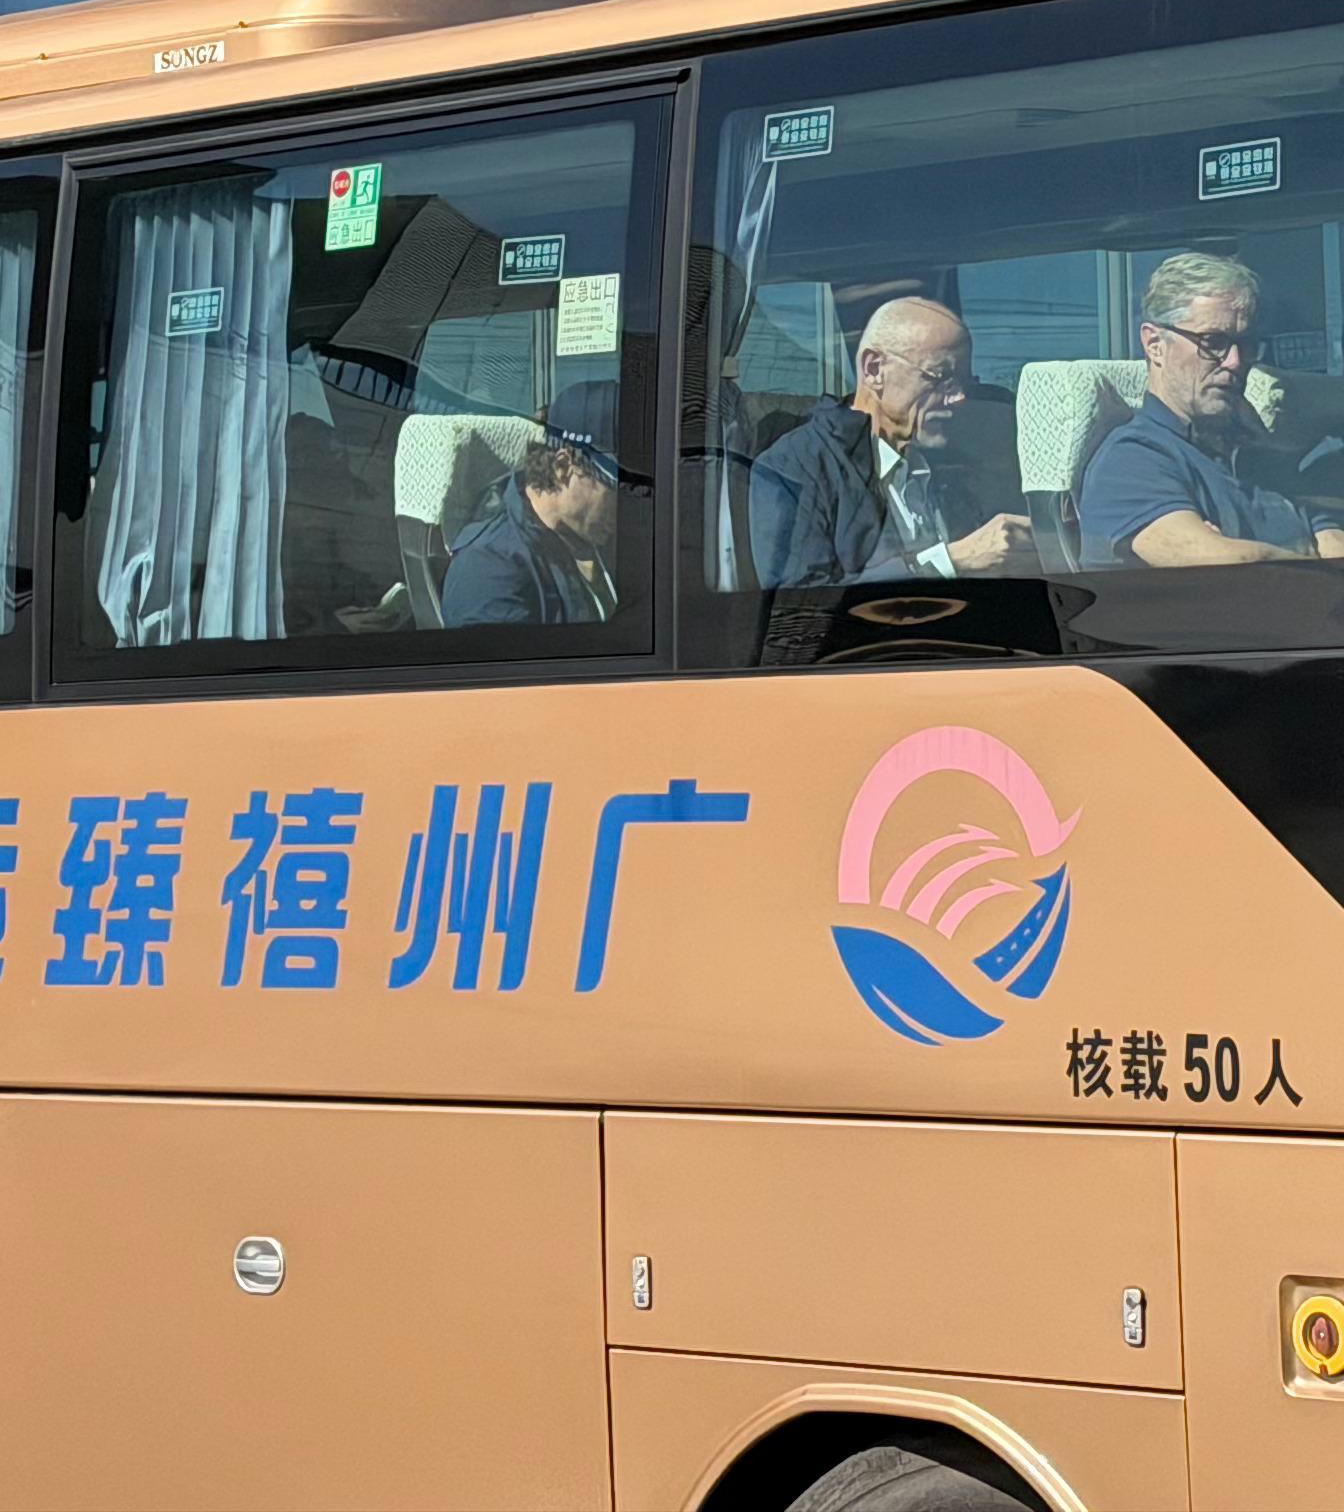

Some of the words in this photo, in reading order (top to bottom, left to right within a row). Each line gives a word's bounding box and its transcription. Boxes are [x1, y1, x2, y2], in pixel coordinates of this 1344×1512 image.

[161, 45, 218, 69] SUNGZ
[563, 276, 617, 303] 应急出口
